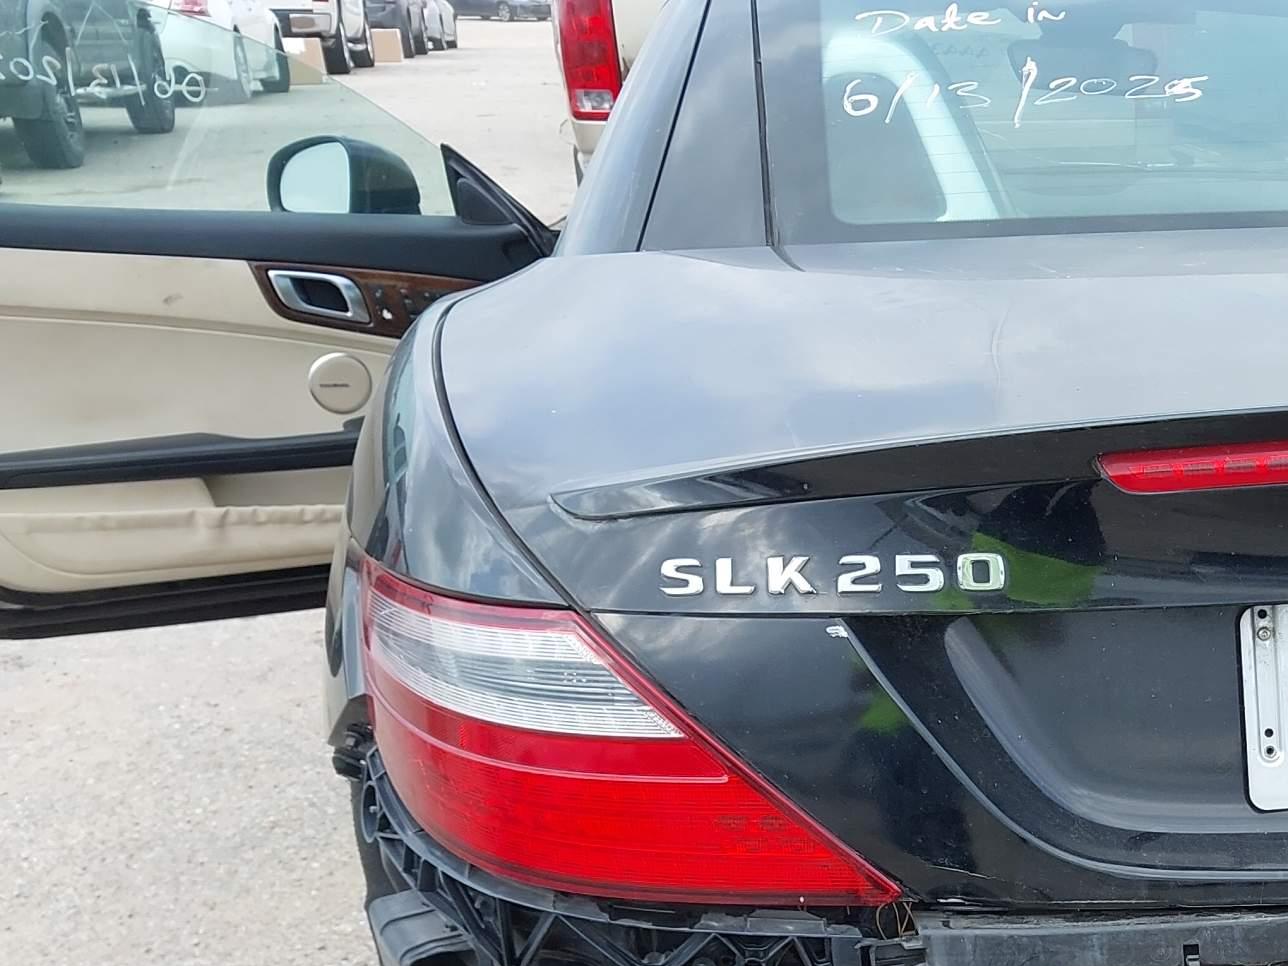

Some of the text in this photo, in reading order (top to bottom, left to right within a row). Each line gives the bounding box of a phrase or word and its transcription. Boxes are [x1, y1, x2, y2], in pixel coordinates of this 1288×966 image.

[854, 1, 1067, 38] Date in
[658, 552, 1006, 596] SLK 250
